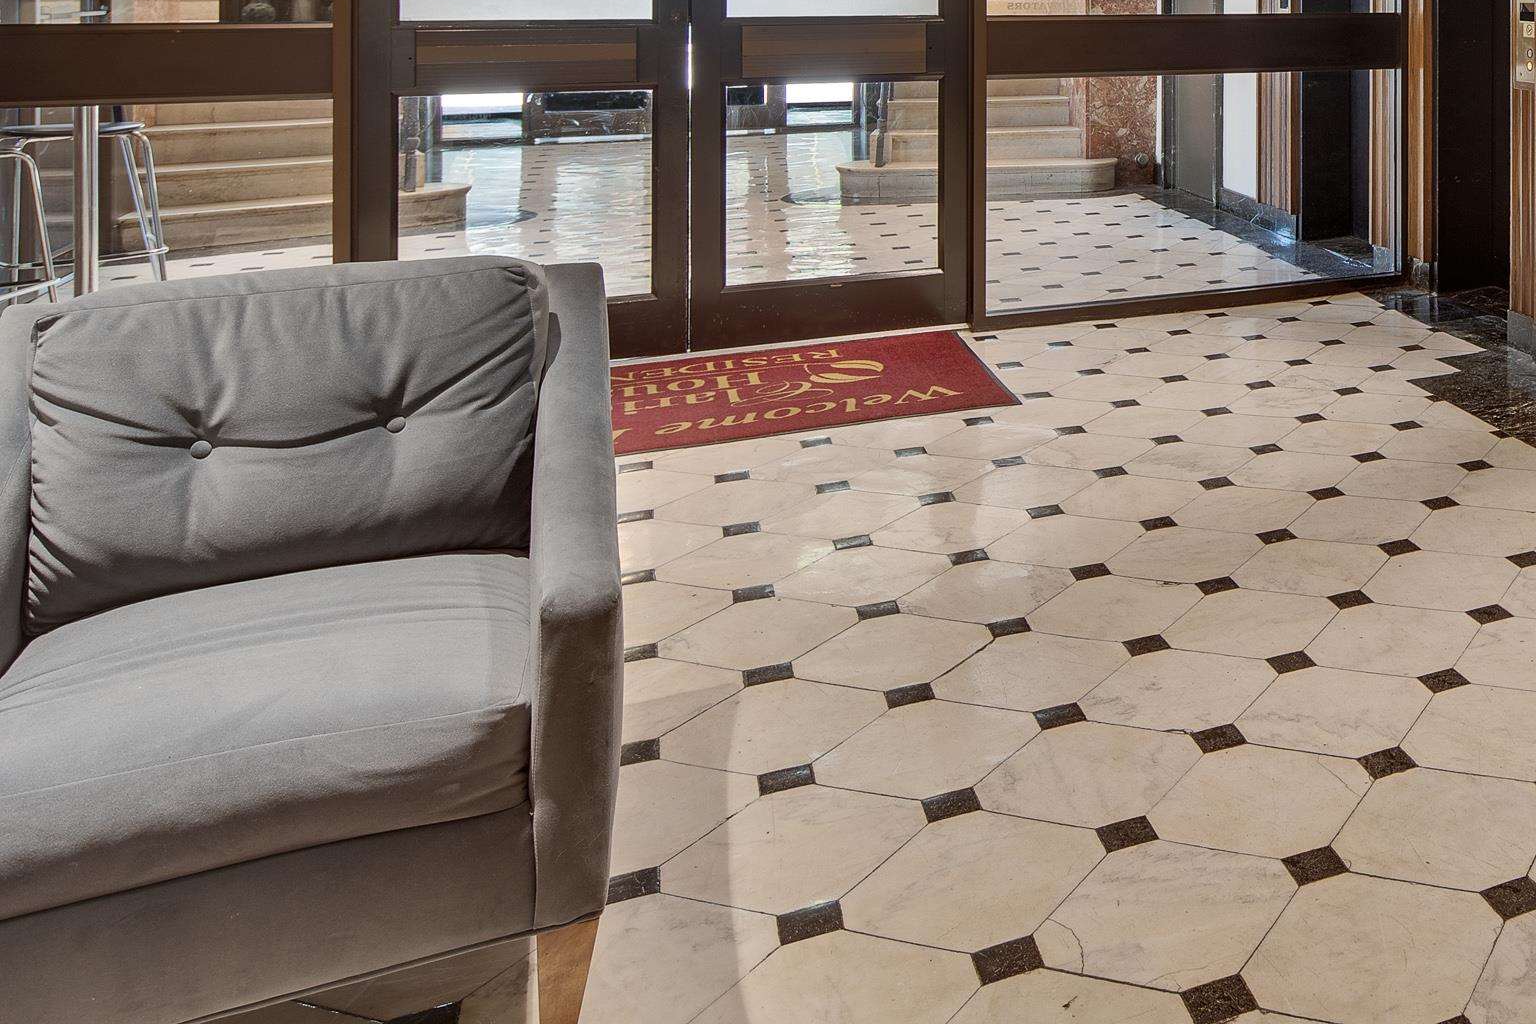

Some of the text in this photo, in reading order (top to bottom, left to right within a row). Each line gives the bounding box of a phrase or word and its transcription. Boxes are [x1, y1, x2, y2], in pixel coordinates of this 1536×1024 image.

[611, 371, 768, 398] Hou
[611, 380, 835, 416] Clari
[654, 384, 964, 436] Welcome
